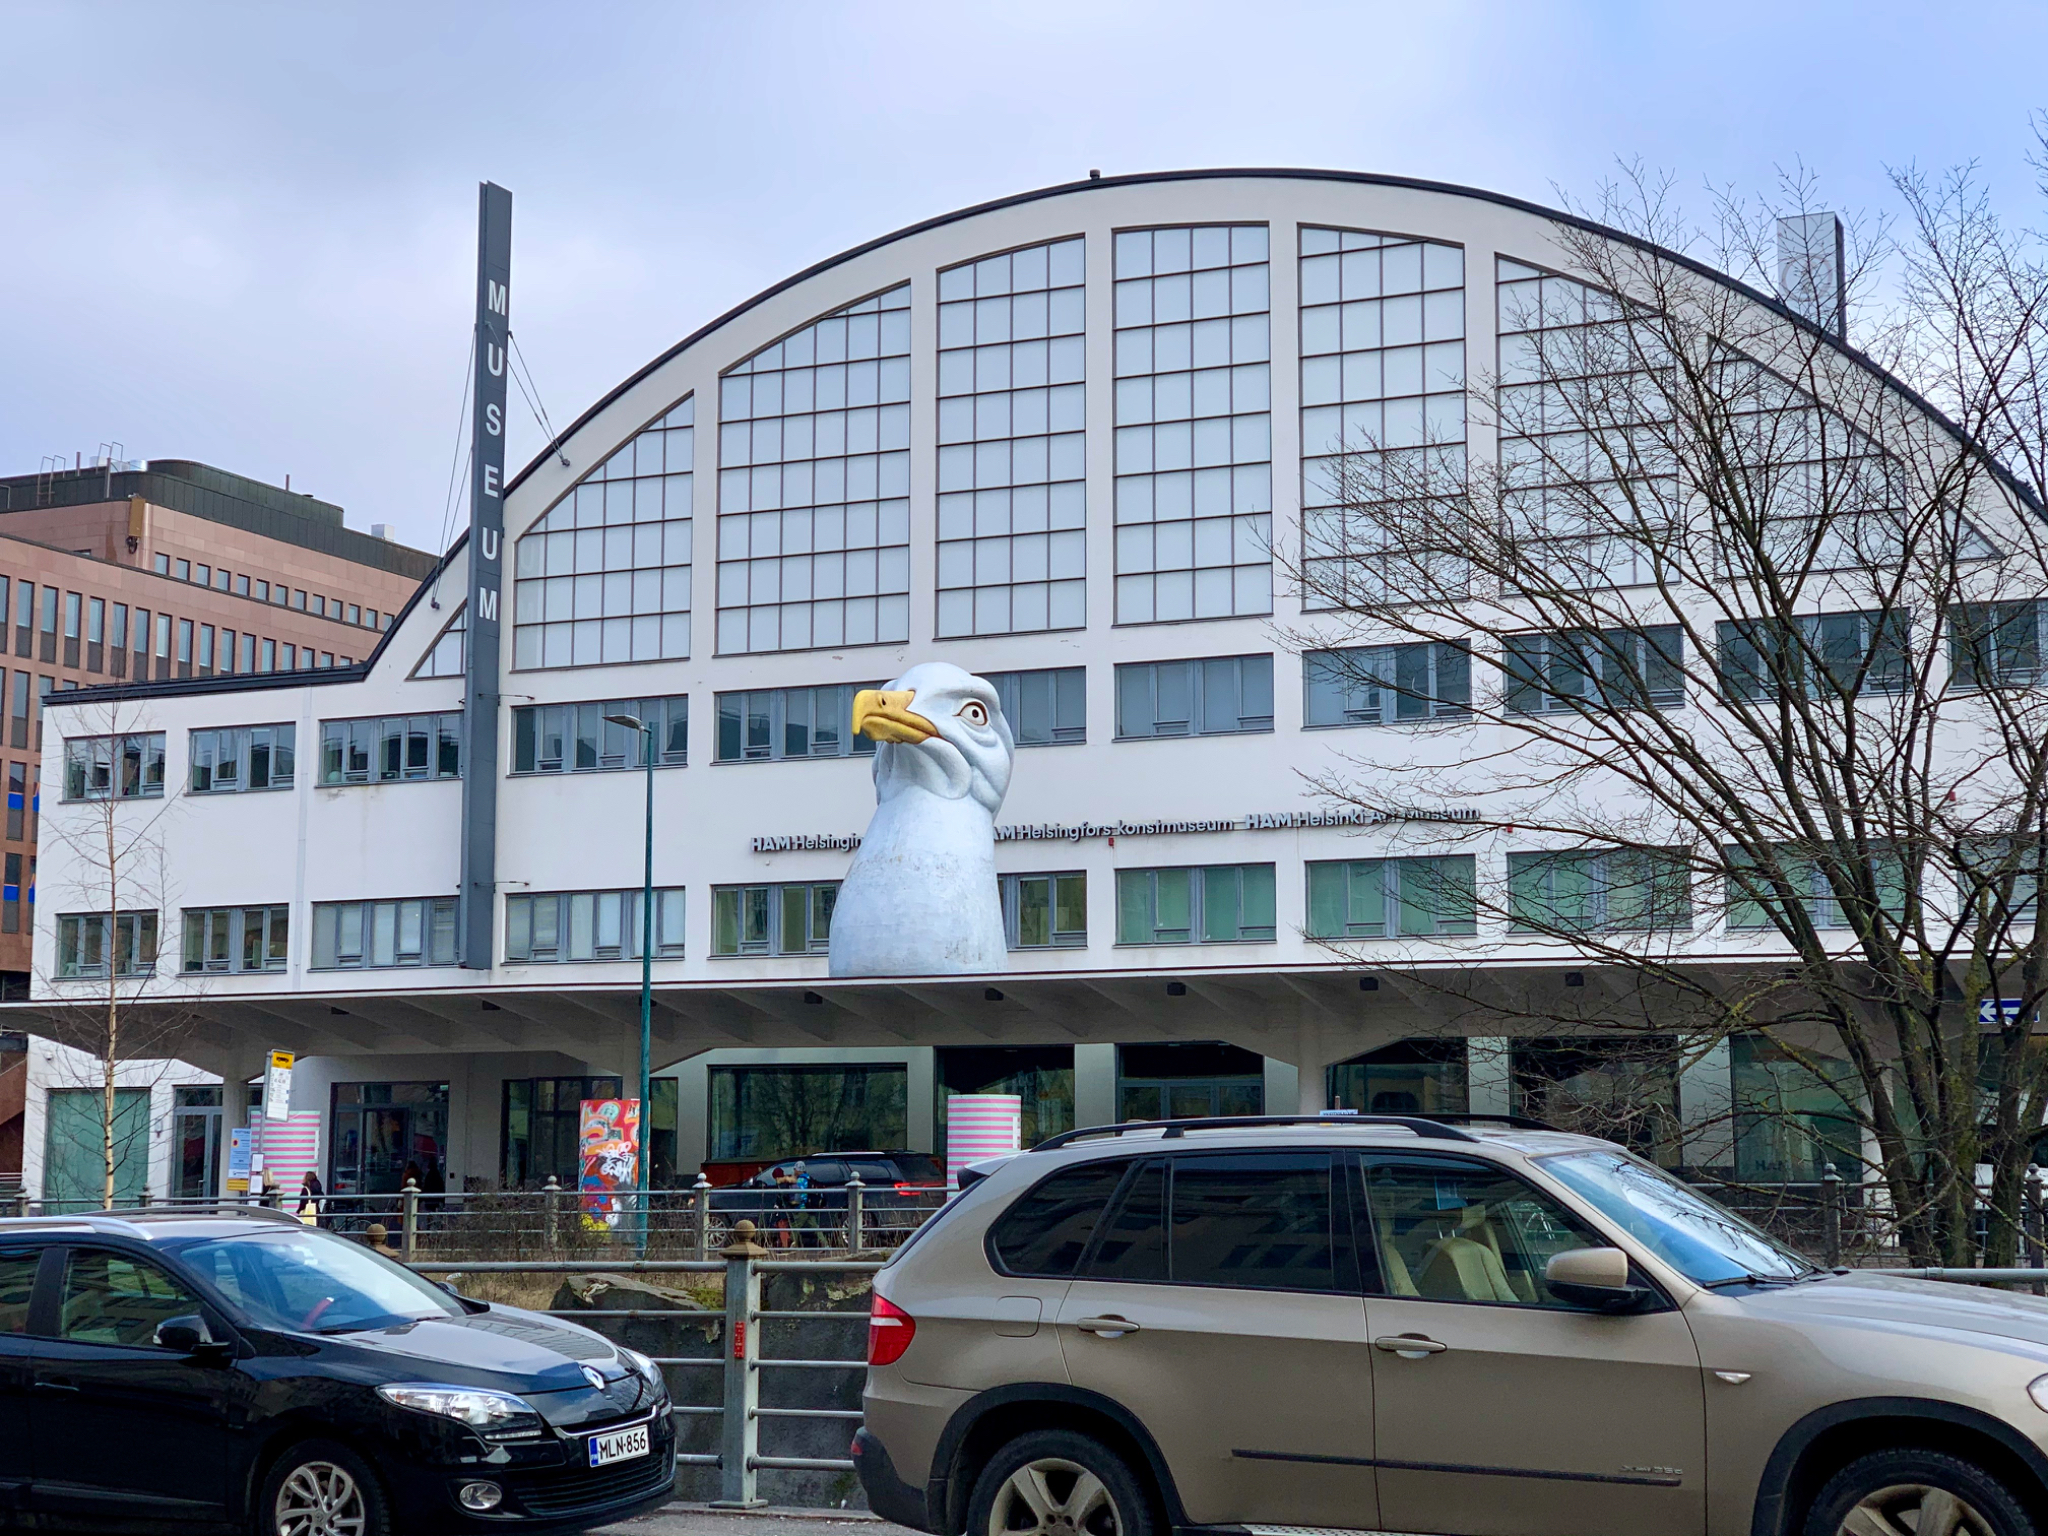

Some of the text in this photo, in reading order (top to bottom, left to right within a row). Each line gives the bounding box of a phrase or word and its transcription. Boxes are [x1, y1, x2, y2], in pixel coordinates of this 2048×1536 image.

[478, 279, 507, 622] MUSEUM
[993, 819, 1234, 841] AM Helsingfors konstmuseum
[1245, 812, 1292, 829] HAM
[1298, 809, 1366, 827] Helsinki
[751, 836, 792, 852] HAM
[599, 1431, 646, 1460] MLN-856
